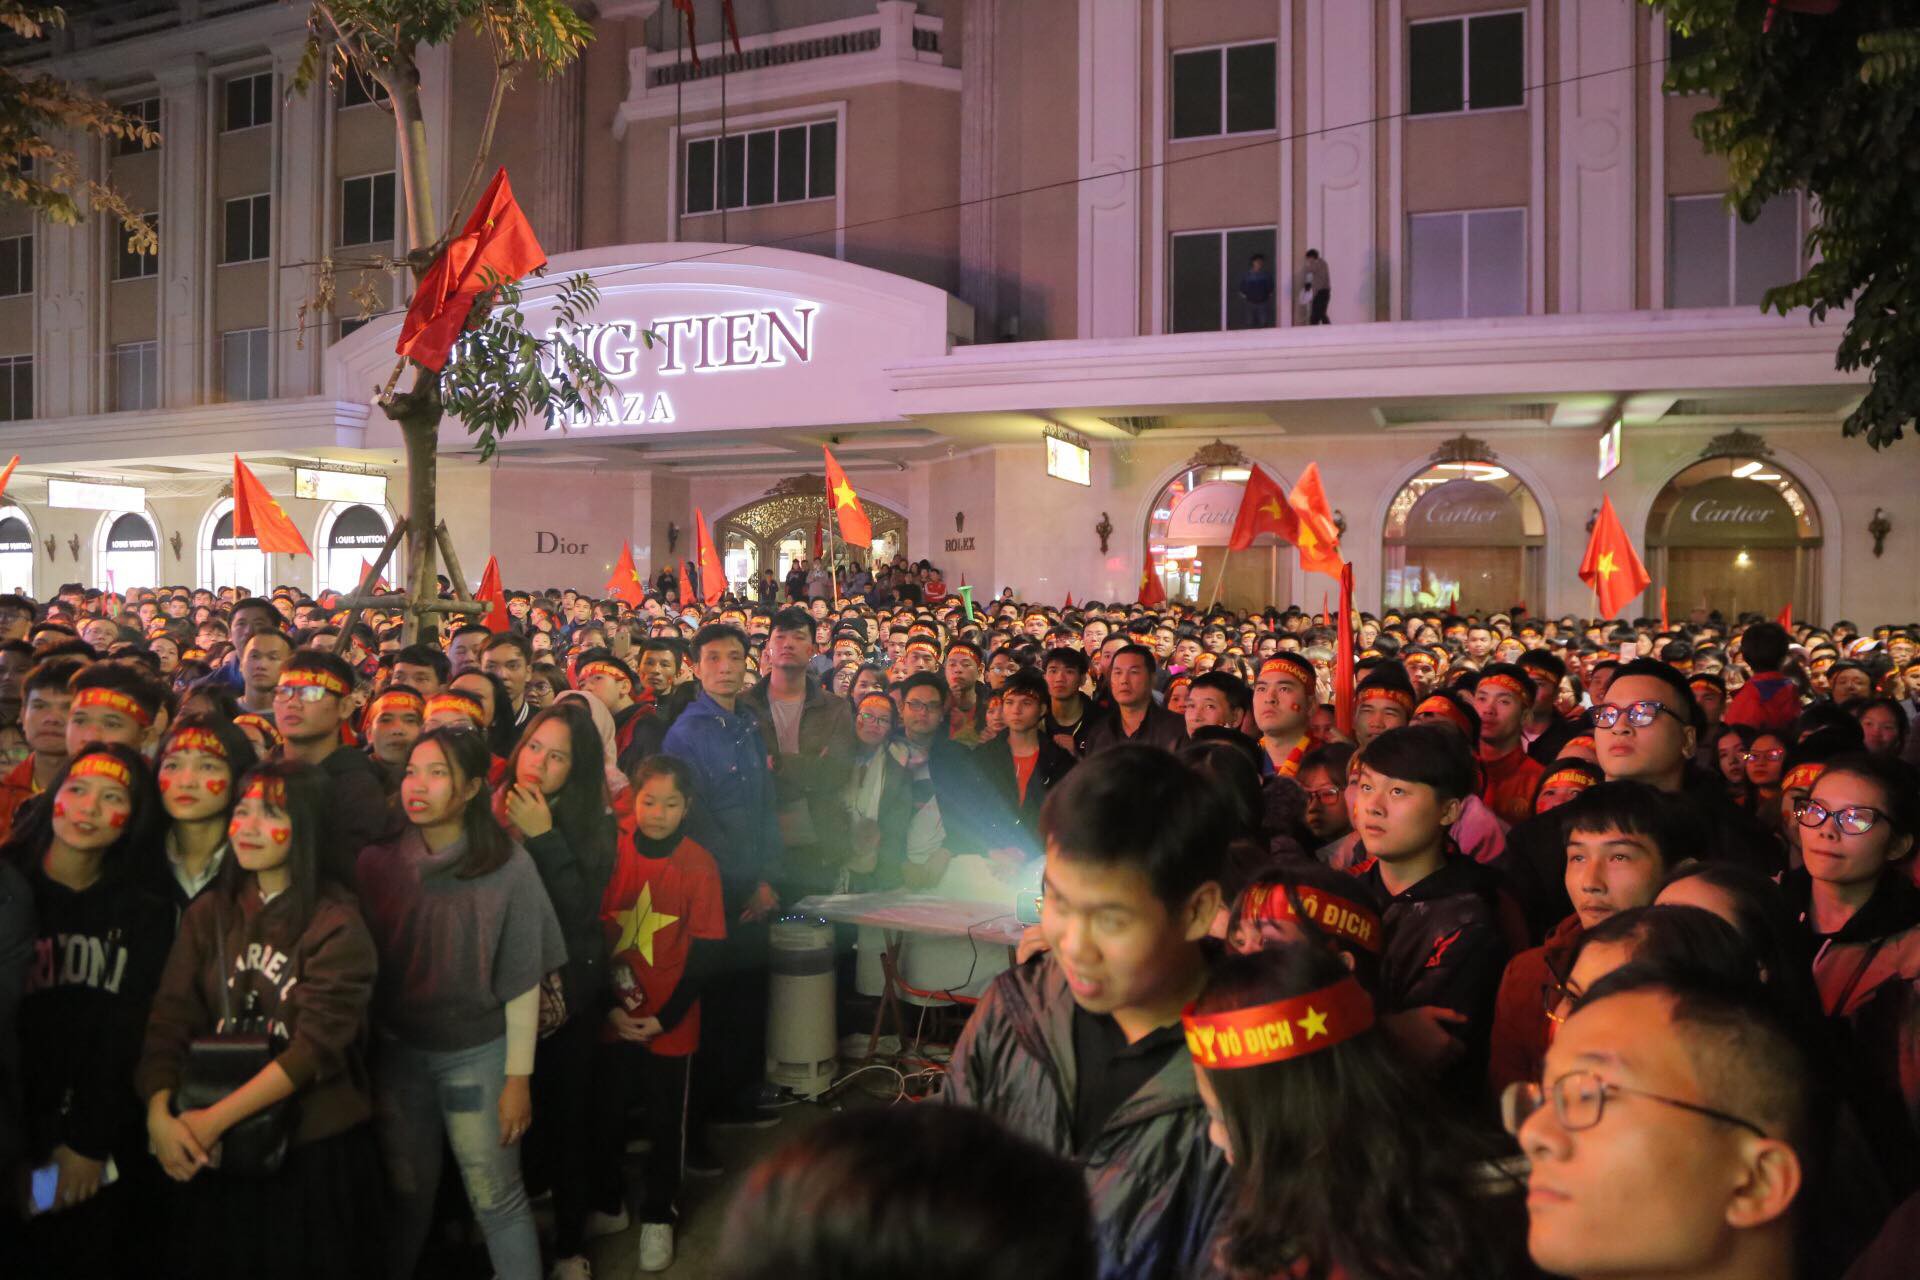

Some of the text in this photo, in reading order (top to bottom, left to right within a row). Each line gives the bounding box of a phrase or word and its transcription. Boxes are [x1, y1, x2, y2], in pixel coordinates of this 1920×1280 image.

[651, 307, 817, 374] TIEN
[1187, 503, 1240, 524] Carti
[1426, 499, 1500, 524] Cartier
[1691, 499, 1775, 522] Cartier
[236, 538, 258, 546] VUITTO
[336, 535, 386, 544] LOUIS VUITTON
[535, 531, 589, 555] Dior
[944, 537, 976, 552] ROLEX
